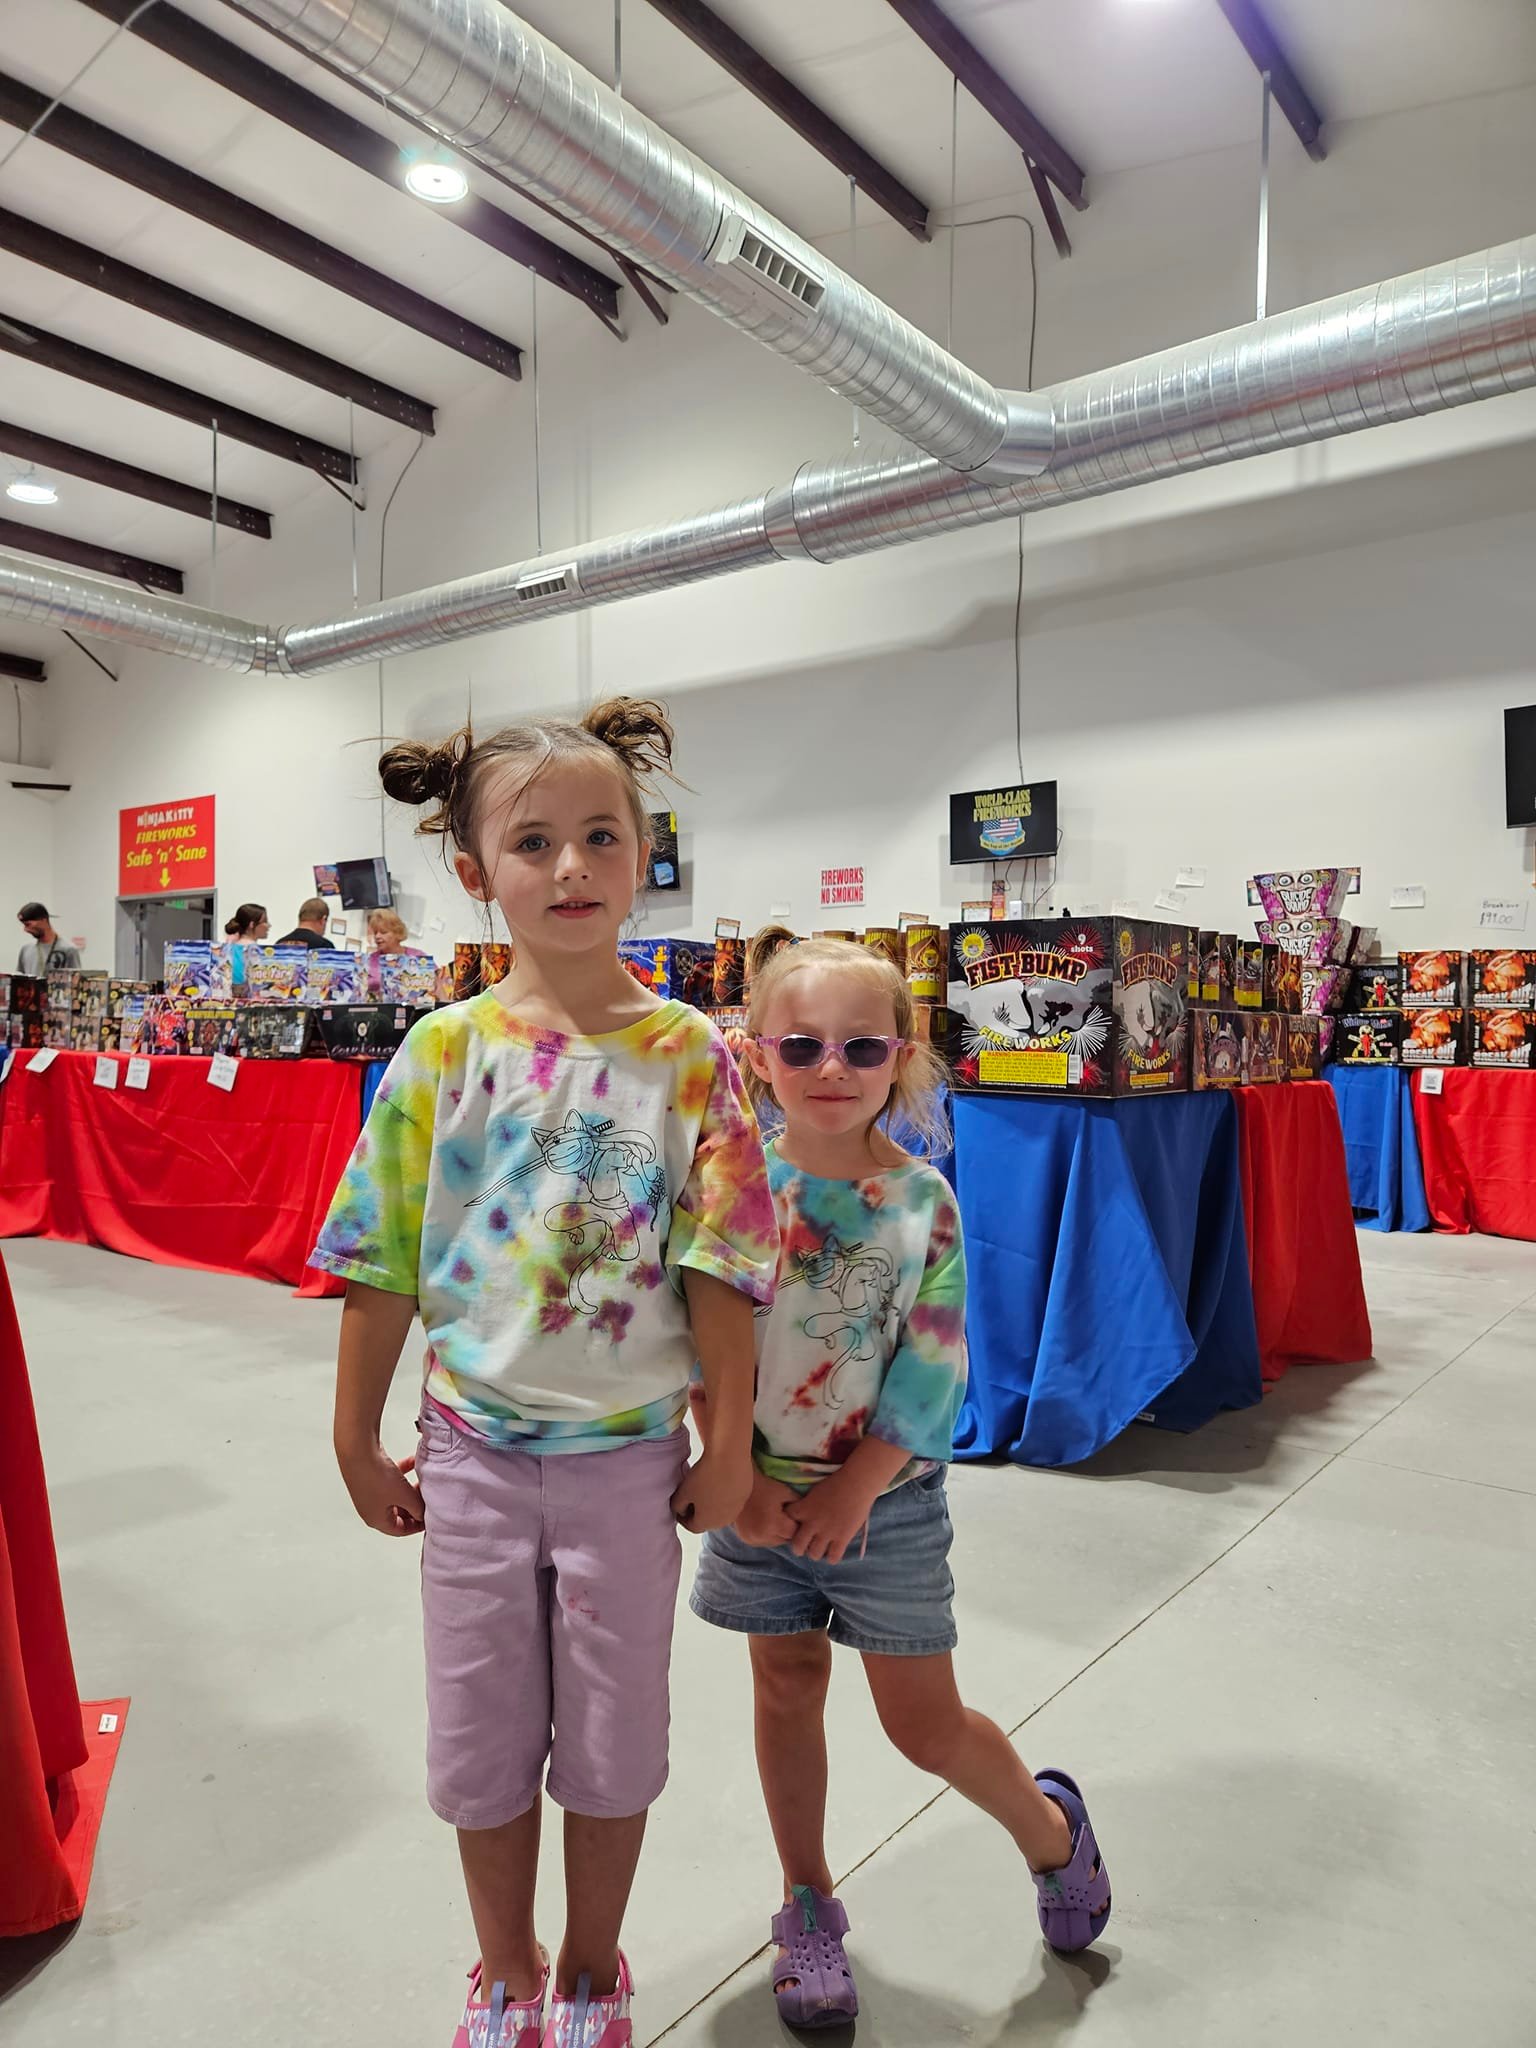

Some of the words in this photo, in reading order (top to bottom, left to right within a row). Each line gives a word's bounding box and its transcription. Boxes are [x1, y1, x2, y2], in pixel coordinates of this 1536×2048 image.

[974, 788, 1031, 808] WORLD-CLASS
[973, 802, 1032, 823] FIREWORKS
[135, 824, 197, 845] FIREWORKS
[126, 848, 153, 868] Safe
[175, 844, 208, 862] Sane
[821, 866, 864, 887] FIREWORKS
[820, 887, 831, 905] NO
[831, 885, 864, 904] SMOKING
[1070, 944, 1094, 953] shots
[1077, 933, 1087, 946] 9
[965, 952, 1017, 990] FIST
[1019, 951, 1088, 986] BUMP
[1121, 953, 1146, 990] FIST
[1147, 952, 1177, 988] BUMP
[979, 1025, 1073, 1050] FIREWORKS
[1127, 1048, 1171, 1070] FIREWORKS
